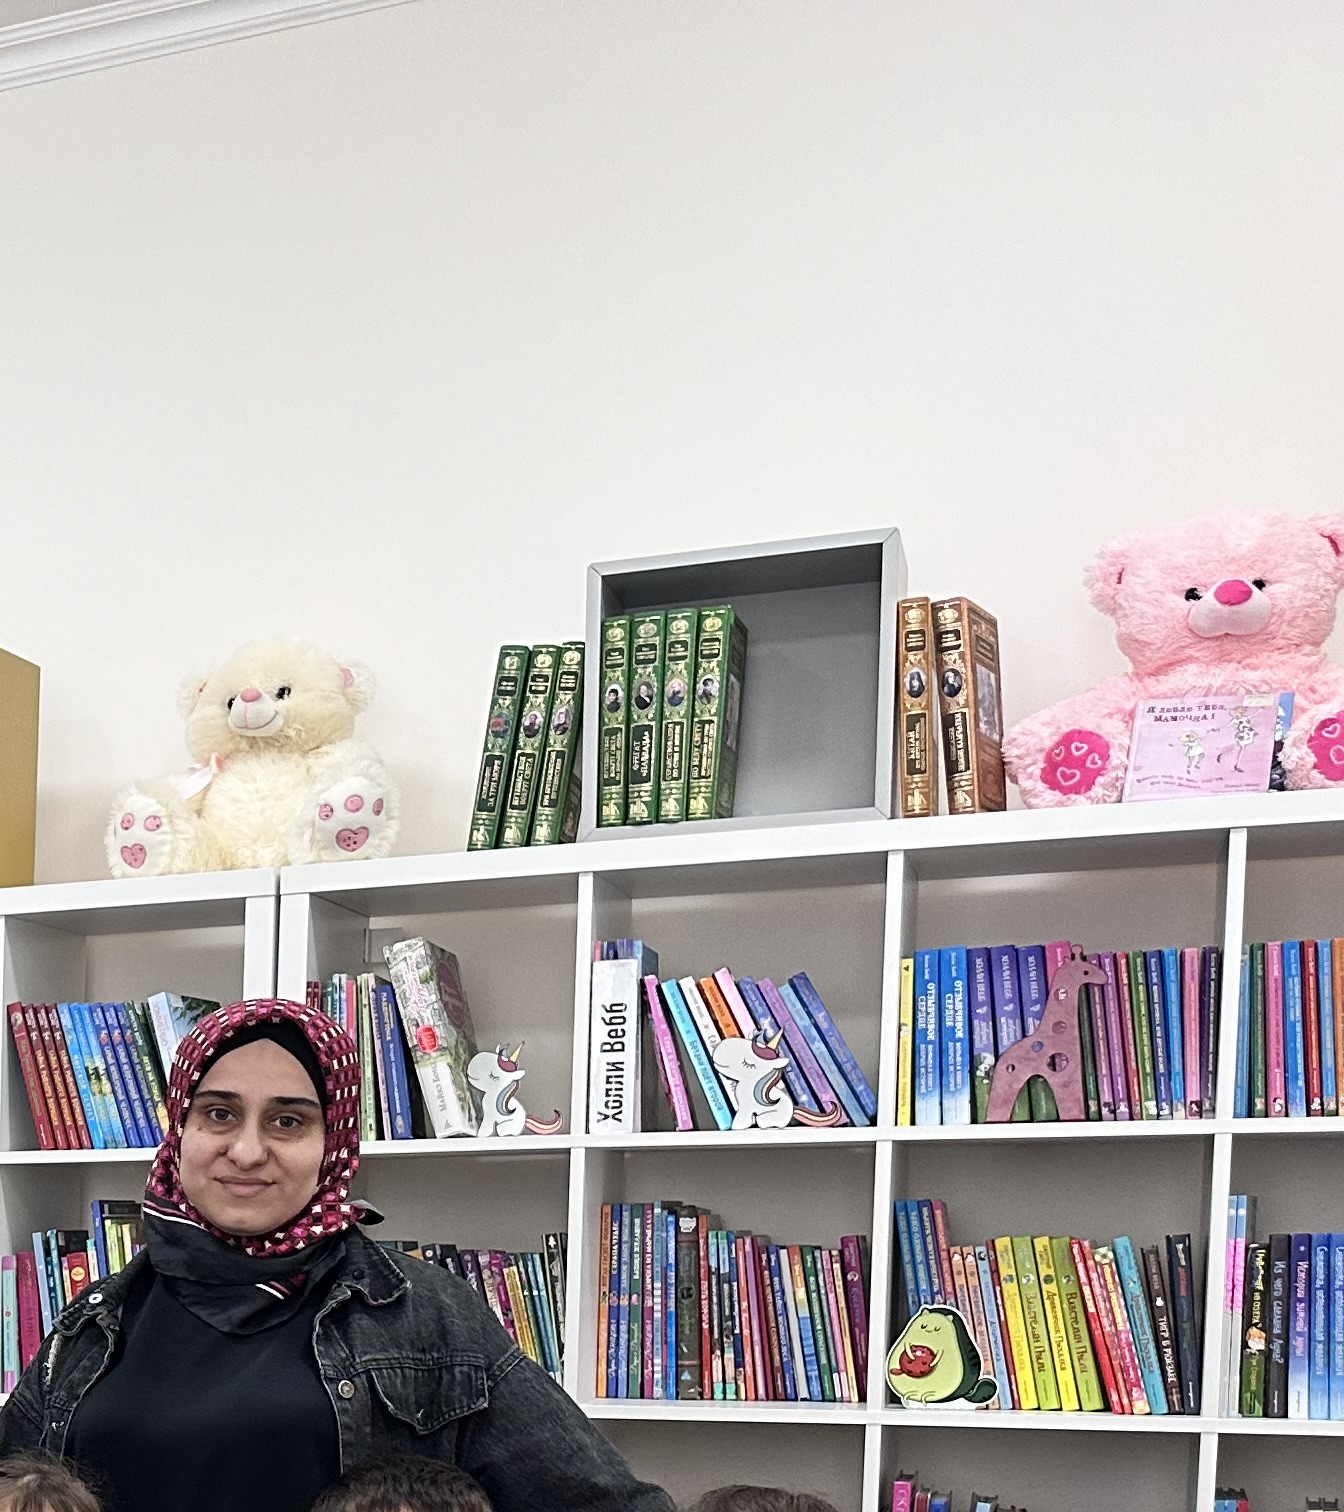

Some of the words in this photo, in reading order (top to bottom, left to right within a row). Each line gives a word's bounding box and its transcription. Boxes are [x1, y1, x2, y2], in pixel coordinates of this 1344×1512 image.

[1153, 712, 1216, 724] МАМОЧКА!
[631, 739, 641, 770] ФРЕГАТ
[598, 1000, 627, 1054] Вебб
[916, 994, 926, 1029] СЕРДЦЕ
[925, 981, 935, 1041] ОТЗЫВЧИВОЕ
[943, 992, 954, 1028] СЕРДЦЕ
[952, 979, 964, 1039] ОТЗЫВЧИВОЕ
[596, 1059, 625, 1123] Холли
[1023, 1291, 1044, 1344] Властелин
[1044, 1288, 1063, 1335] Дракончик
[1064, 1290, 1085, 1344] Властелин
[1156, 1315, 1170, 1339] ТИГР
[1032, 1343, 1049, 1373] Пыли
[1074, 1344, 1091, 1374] Пыли
[1161, 1346, 1177, 1383] РЮКЗАКЕ
